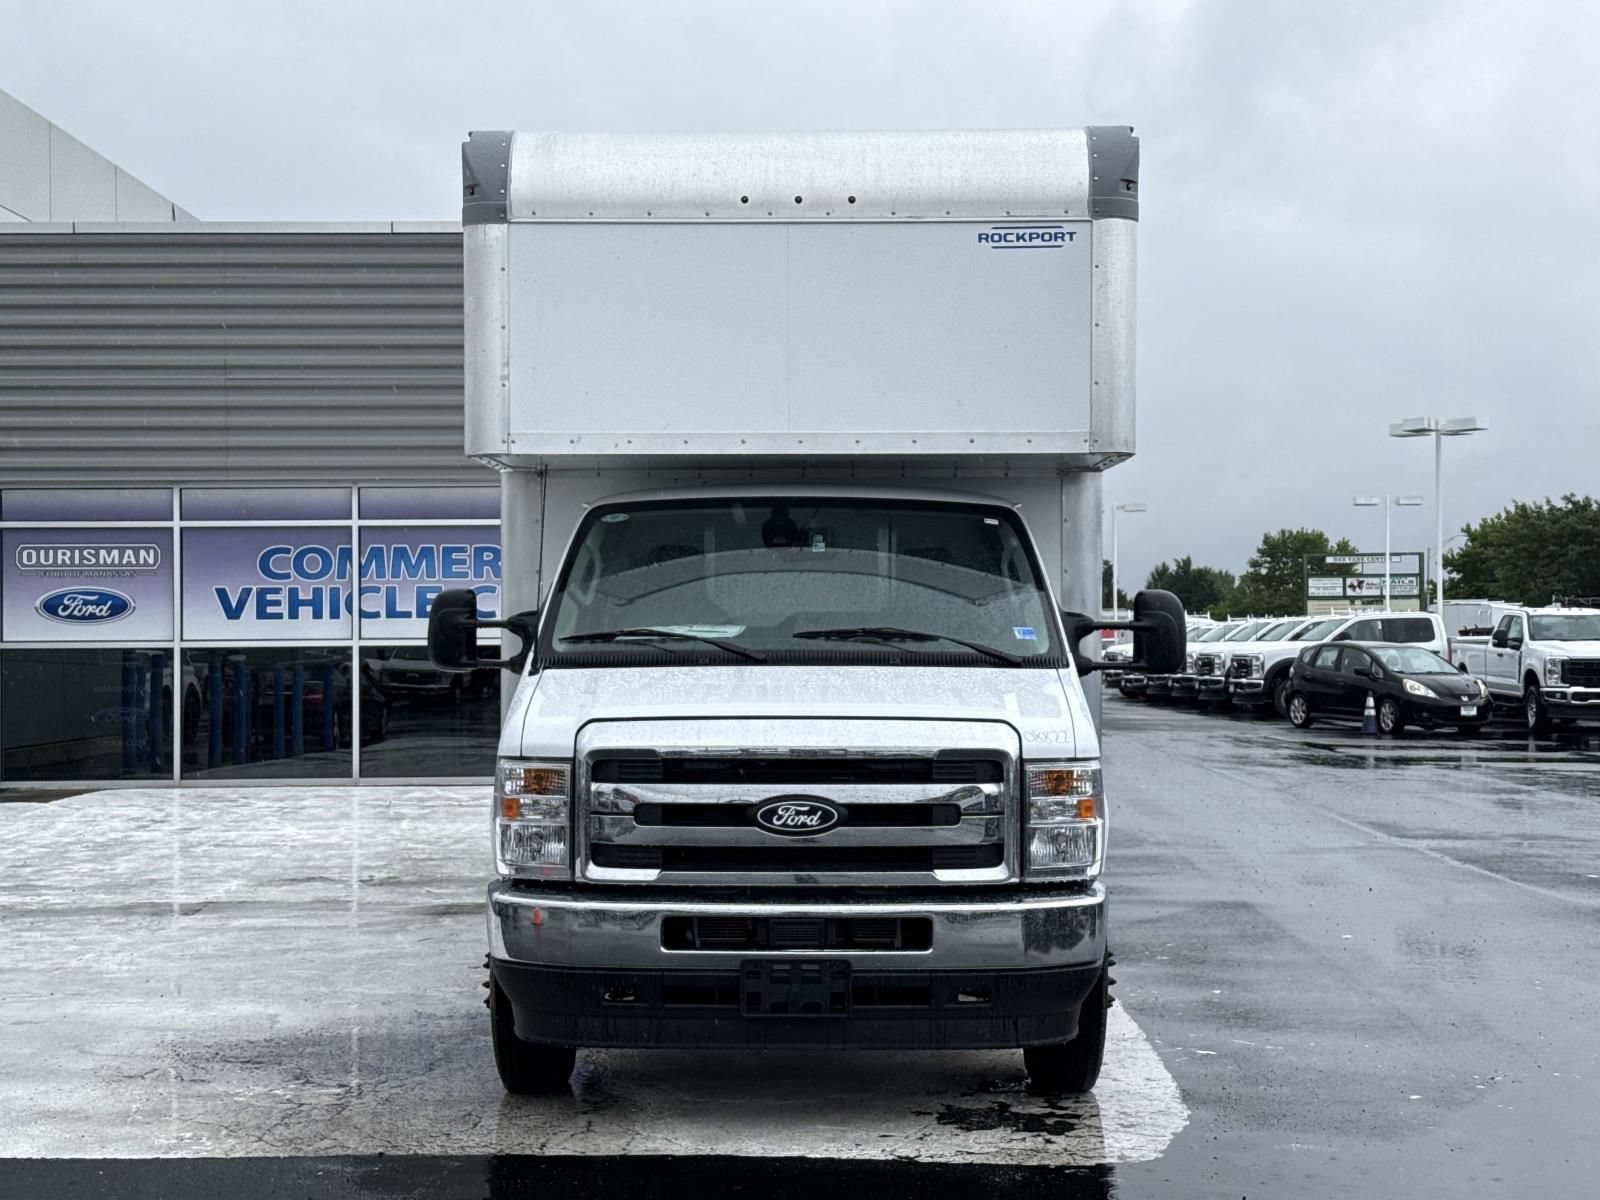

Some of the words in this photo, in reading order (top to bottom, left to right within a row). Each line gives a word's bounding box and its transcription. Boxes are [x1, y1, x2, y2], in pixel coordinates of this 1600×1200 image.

[978, 232, 1077, 243] ROCKPORT
[22, 549, 155, 565] OURISMAN
[257, 545, 501, 582] COMMER
[58, 594, 112, 616] Ford
[213, 584, 444, 621] VEHICLE
[773, 805, 822, 826] Ford
